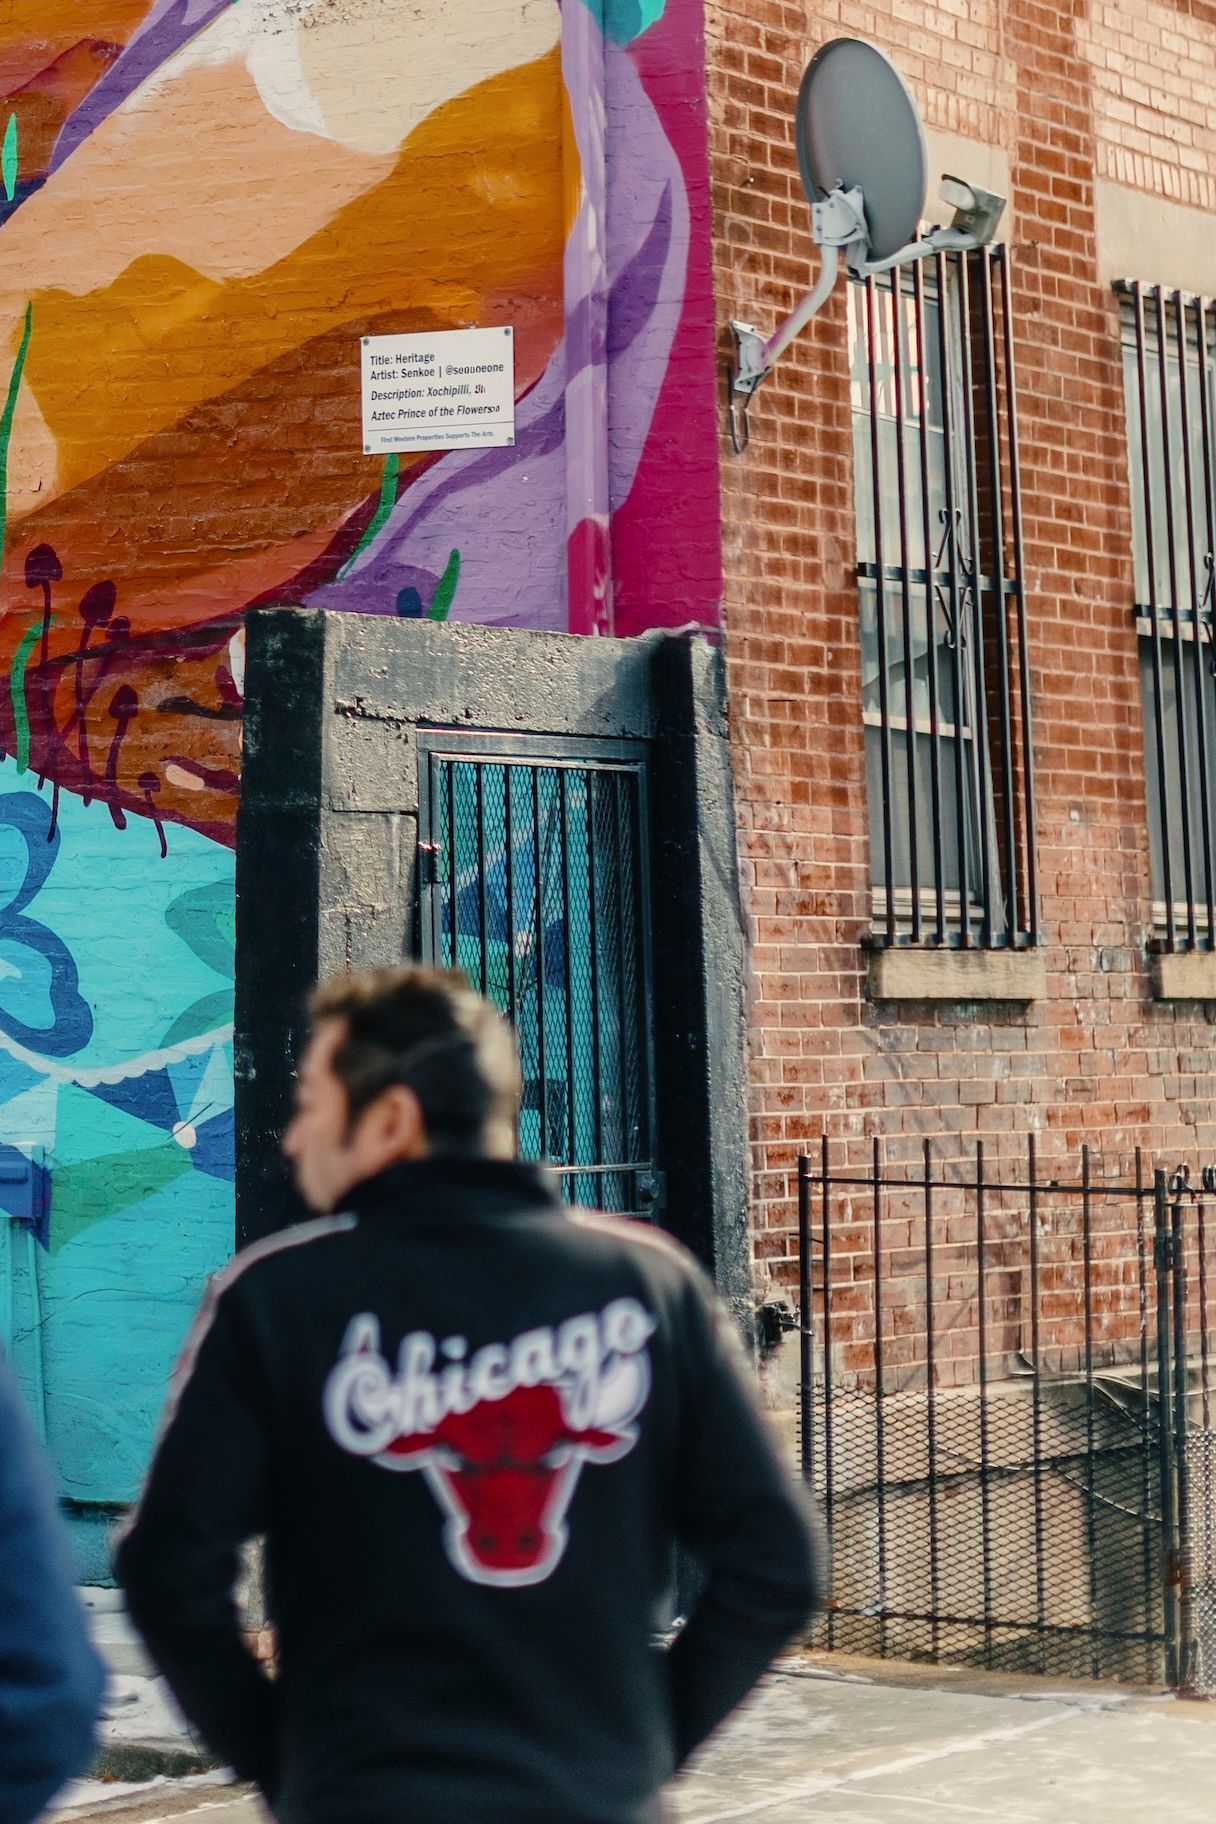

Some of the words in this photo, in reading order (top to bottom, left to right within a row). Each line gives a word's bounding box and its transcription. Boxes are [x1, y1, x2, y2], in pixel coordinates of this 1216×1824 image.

[370, 355, 393, 366] Title:
[395, 352, 435, 365] Heritage
[370, 369, 399, 381] Artist:
[401, 367, 435, 378] Senkoe
[371, 390, 425, 401] Description:
[427, 384, 472, 397] Xochipilli,
[371, 409, 396, 421] Aztec
[397, 407, 426, 420] Prince
[428, 406, 439, 417] of
[439, 405, 454, 417] the
[394, 435, 415, 443] Western
[416, 434, 444, 442] Properties
[445, 432, 470, 440] Supports
[323, 1297, 656, 1455] Chicago
